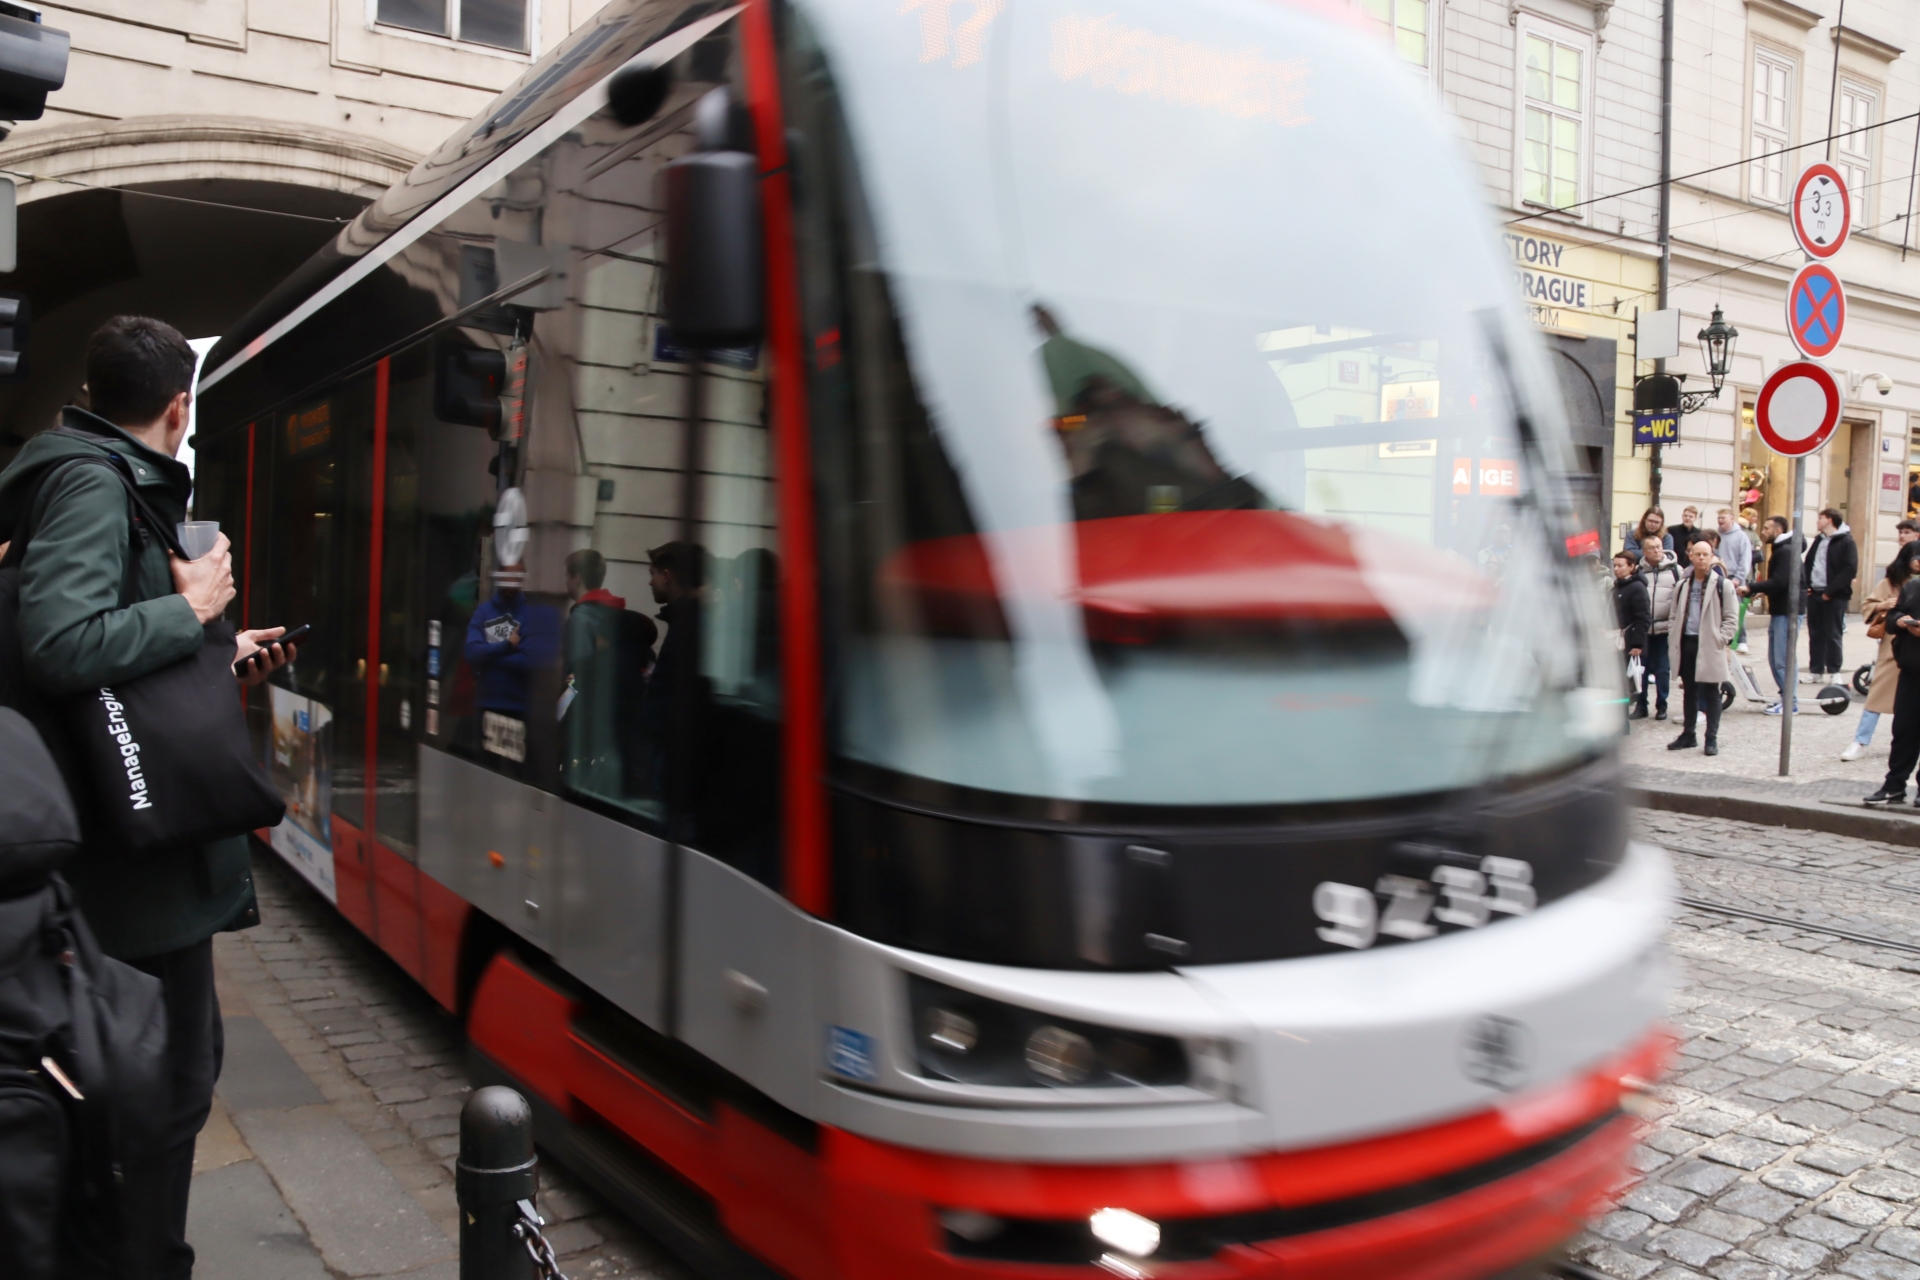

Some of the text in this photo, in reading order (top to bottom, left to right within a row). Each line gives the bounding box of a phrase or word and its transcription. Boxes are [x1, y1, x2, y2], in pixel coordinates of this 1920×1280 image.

[1817, 220, 1826, 230] m
[1501, 232, 1563, 267] STORY
[1524, 305, 1559, 327] SEUM
[1651, 418, 1675, 438] WC
[99, 687, 152, 810] ManageEngin
[1312, 854, 1538, 950] 9233
